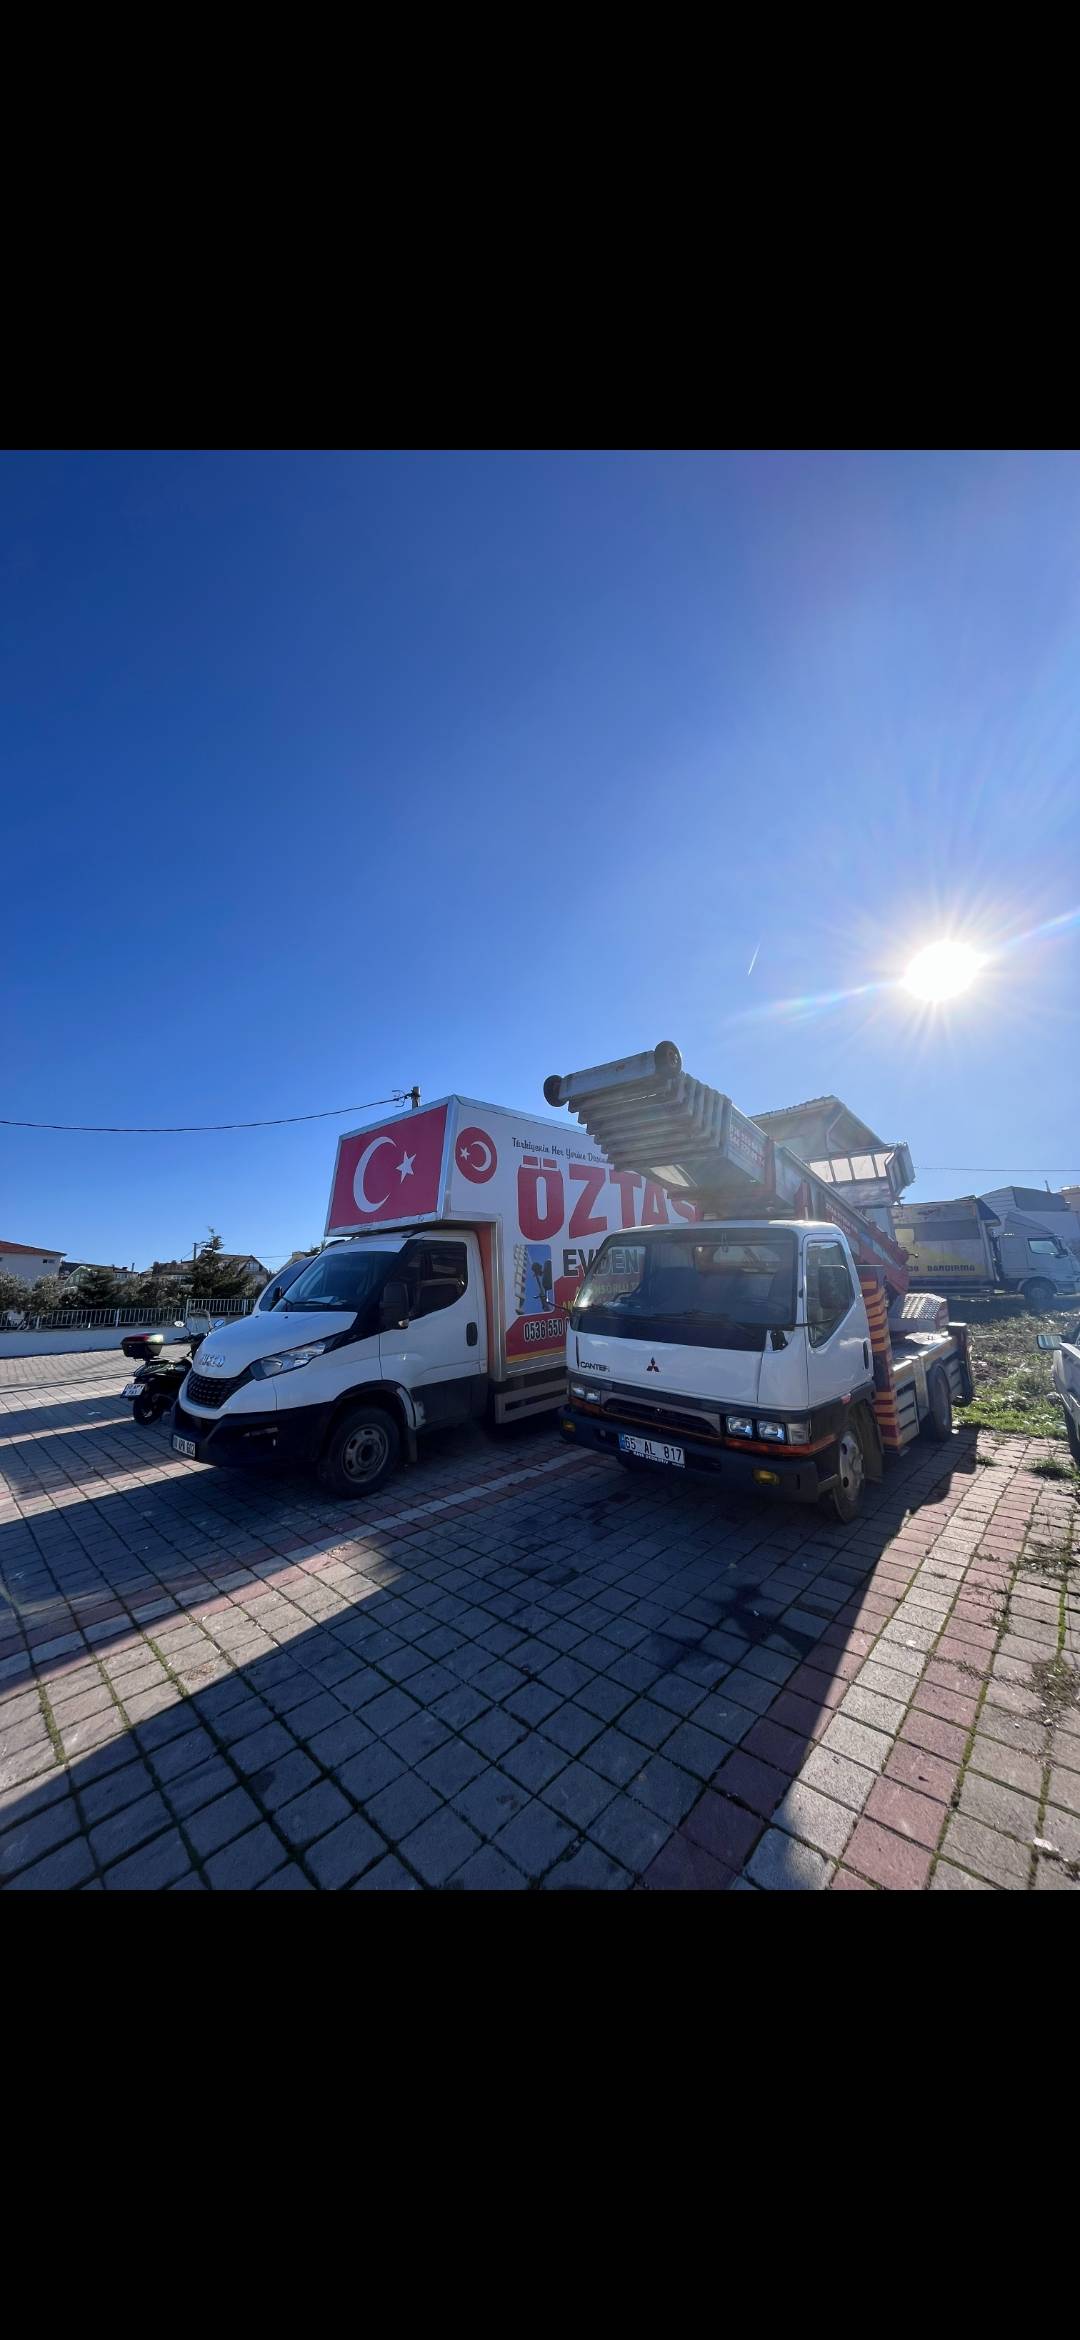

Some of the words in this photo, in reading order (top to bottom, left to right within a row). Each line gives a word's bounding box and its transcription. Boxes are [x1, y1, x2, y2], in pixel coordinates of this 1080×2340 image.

[524, 1322, 547, 1342] 0536
[547, 1318, 564, 1338] 550
[625, 1436, 637, 1450] 65
[645, 1441, 656, 1456] AL
[663, 1446, 682, 1462] 817
